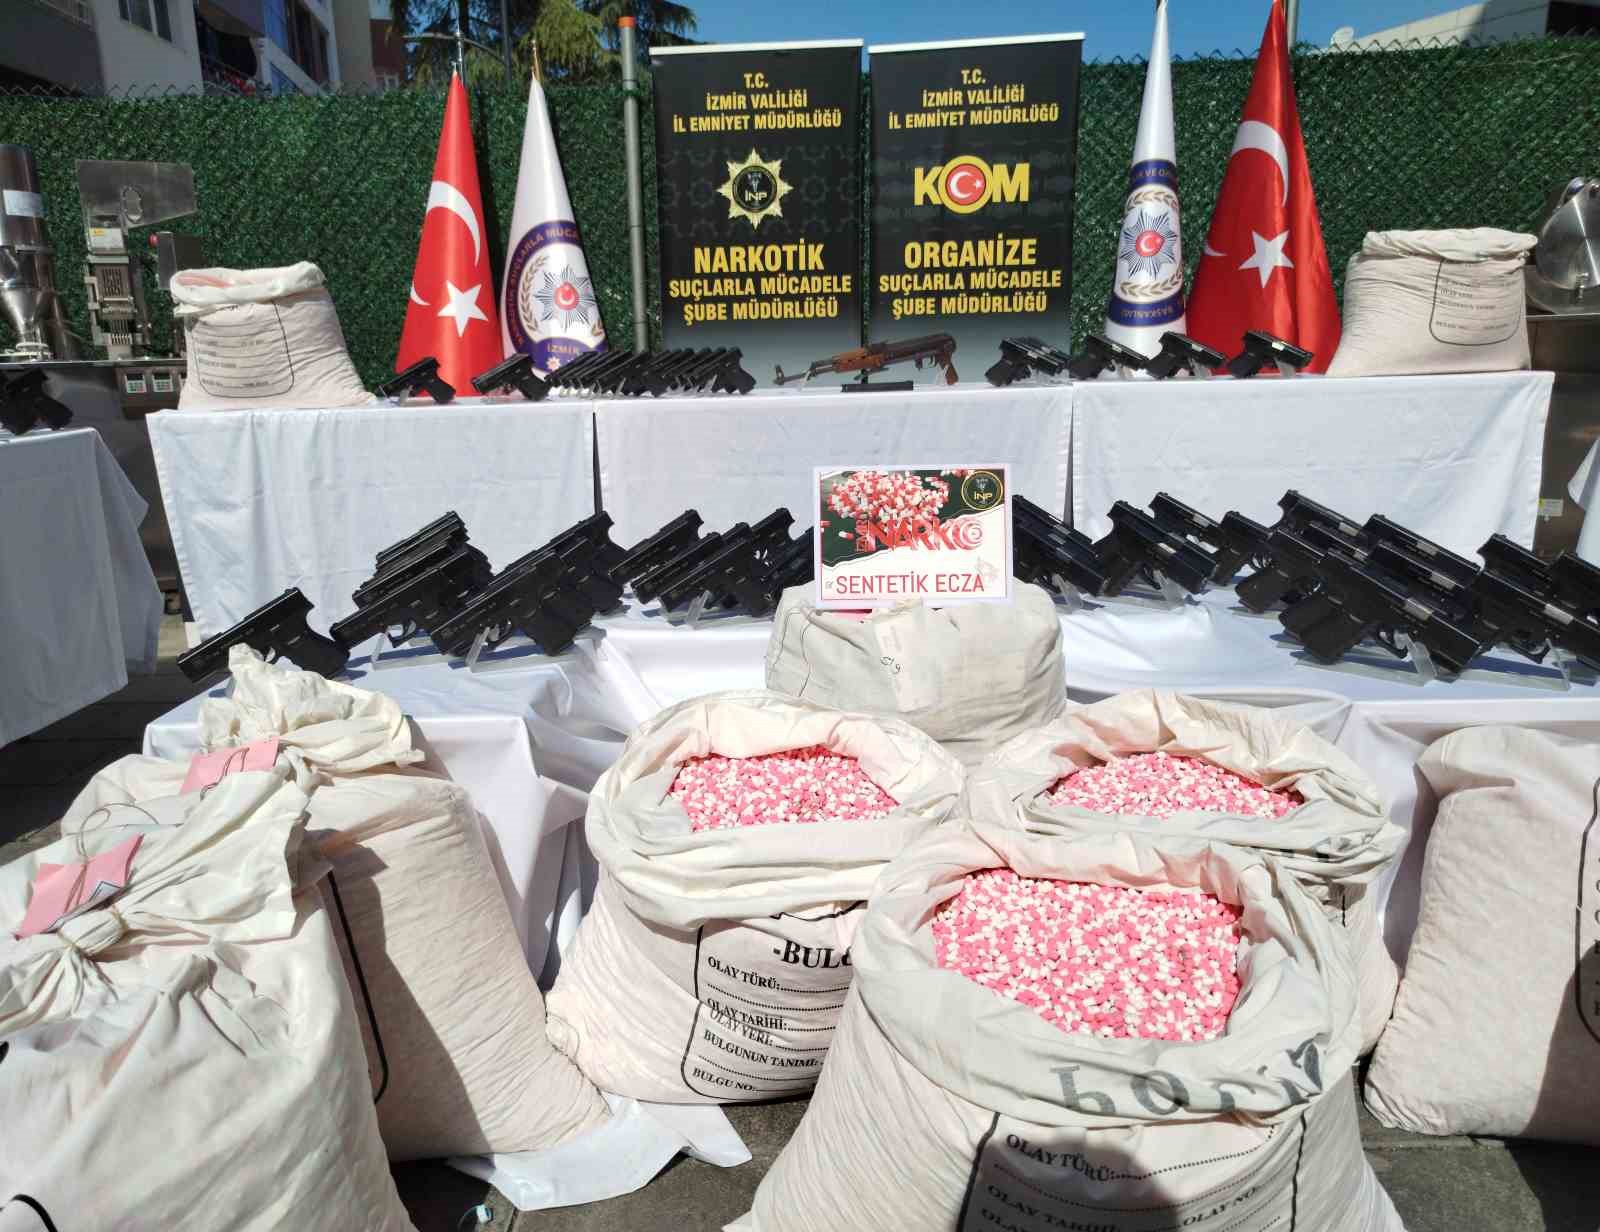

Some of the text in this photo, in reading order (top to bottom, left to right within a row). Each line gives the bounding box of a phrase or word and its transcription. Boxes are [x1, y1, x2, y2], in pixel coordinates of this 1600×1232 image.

[744, 72, 769, 89] T.C.
[961, 69, 986, 85] T.C.
[706, 88, 808, 111] İZMİR VALİLİĞİ
[922, 84, 1025, 108] İZMİR VALİLİĞİ
[673, 108, 842, 133] İL EMNİYET MÜDÜRLÜĞÜ
[888, 103, 1060, 129] İL EMNİYET MÜDÜRLÜĞÜ
[914, 155, 1030, 214] KOM
[693, 238, 825, 274] NARKOTİK
[904, 233, 1037, 269] ORGANİZE
[669, 273, 852, 301] SUÇLARLA MÜCADELE
[879, 268, 1062, 296] SUÇLARLA MÜCADELE
[683, 296, 839, 326] ŞUBE MÜDÜRLÜĞÜ
[892, 291, 1047, 320] ŞUBE MÜDÜRLÜĞÜ
[836, 571, 985, 594] SENTETİK ECZA
[707, 956, 741, 979] OLAY
[703, 1029, 769, 1064] BULGUNUN
[692, 1068, 734, 1088] BULGU
[1006, 1134, 1058, 1166] OLAY
[987, 1184, 1041, 1217] OLAY
